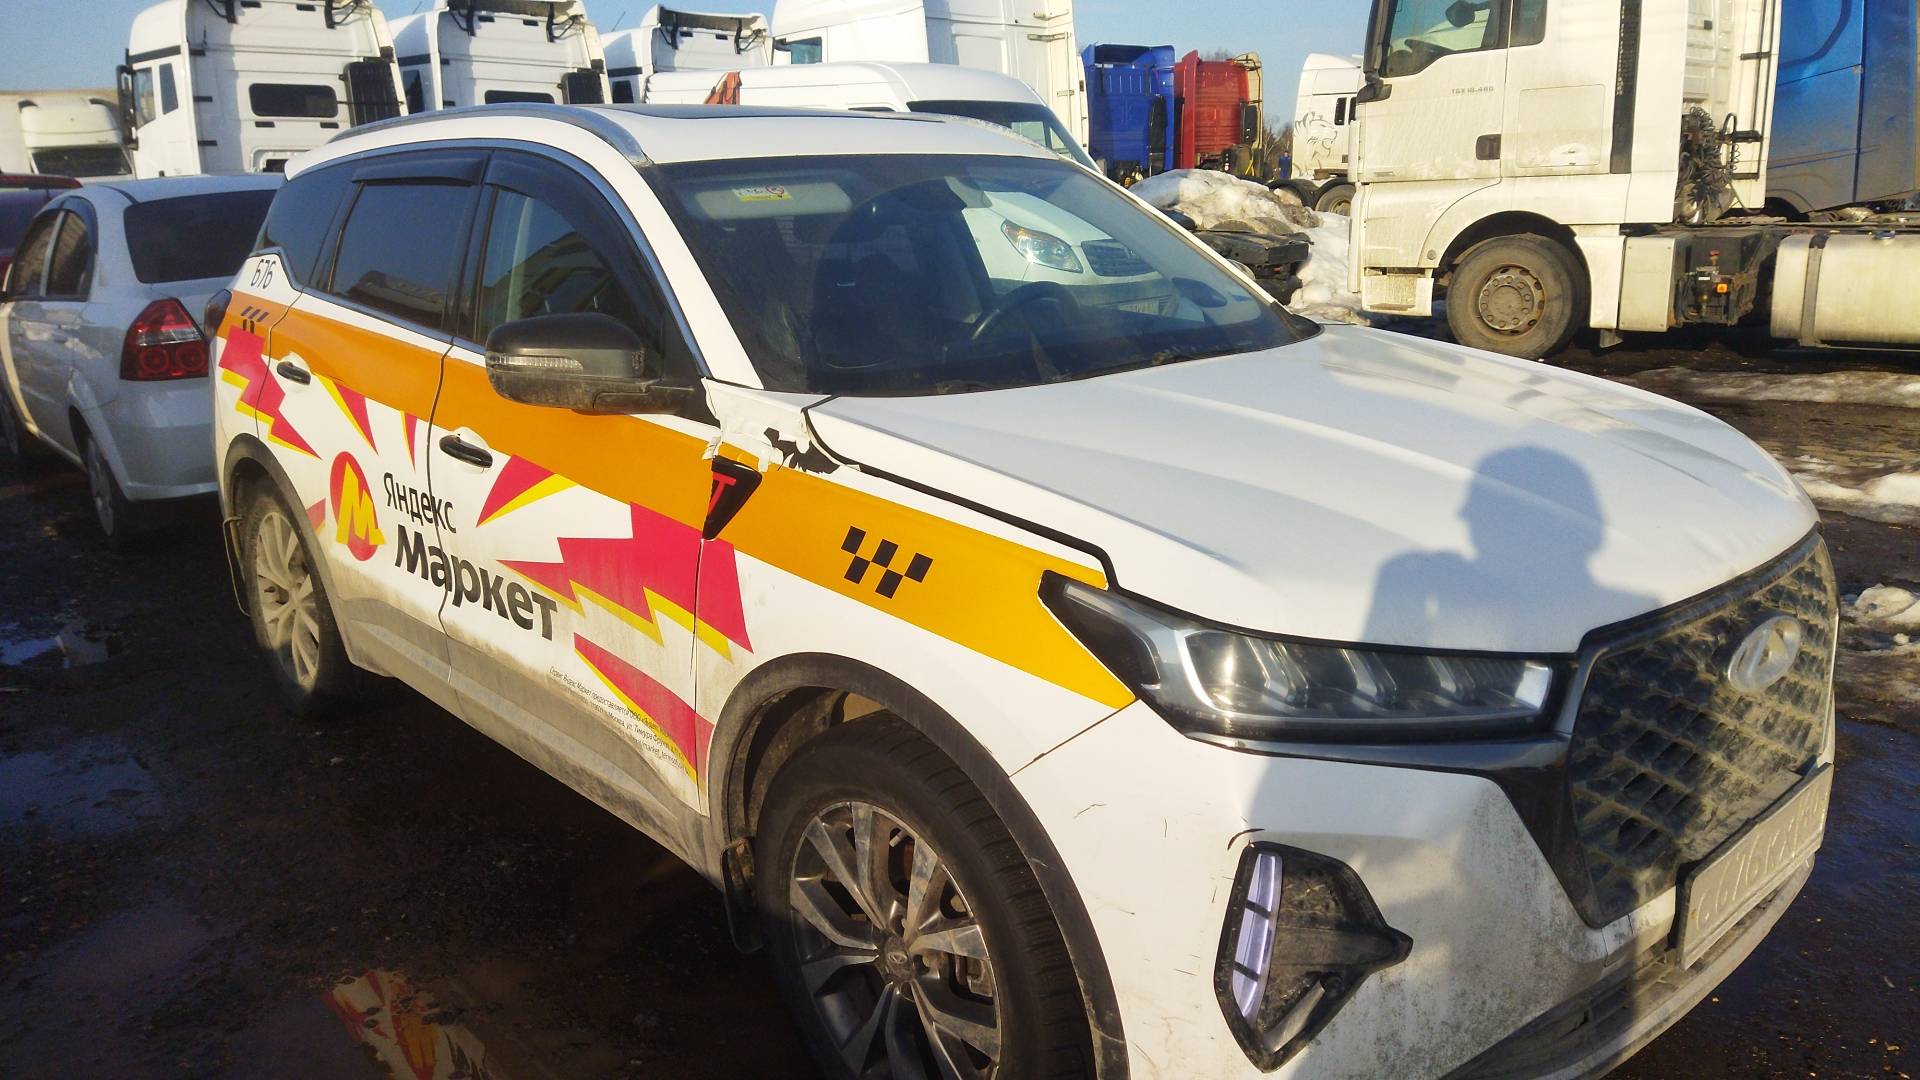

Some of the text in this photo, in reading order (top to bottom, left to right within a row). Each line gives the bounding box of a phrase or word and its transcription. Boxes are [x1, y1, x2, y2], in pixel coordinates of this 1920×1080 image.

[250, 258, 277, 289] 676
[383, 472, 457, 534] Яндекс
[394, 523, 558, 641] Маркет
